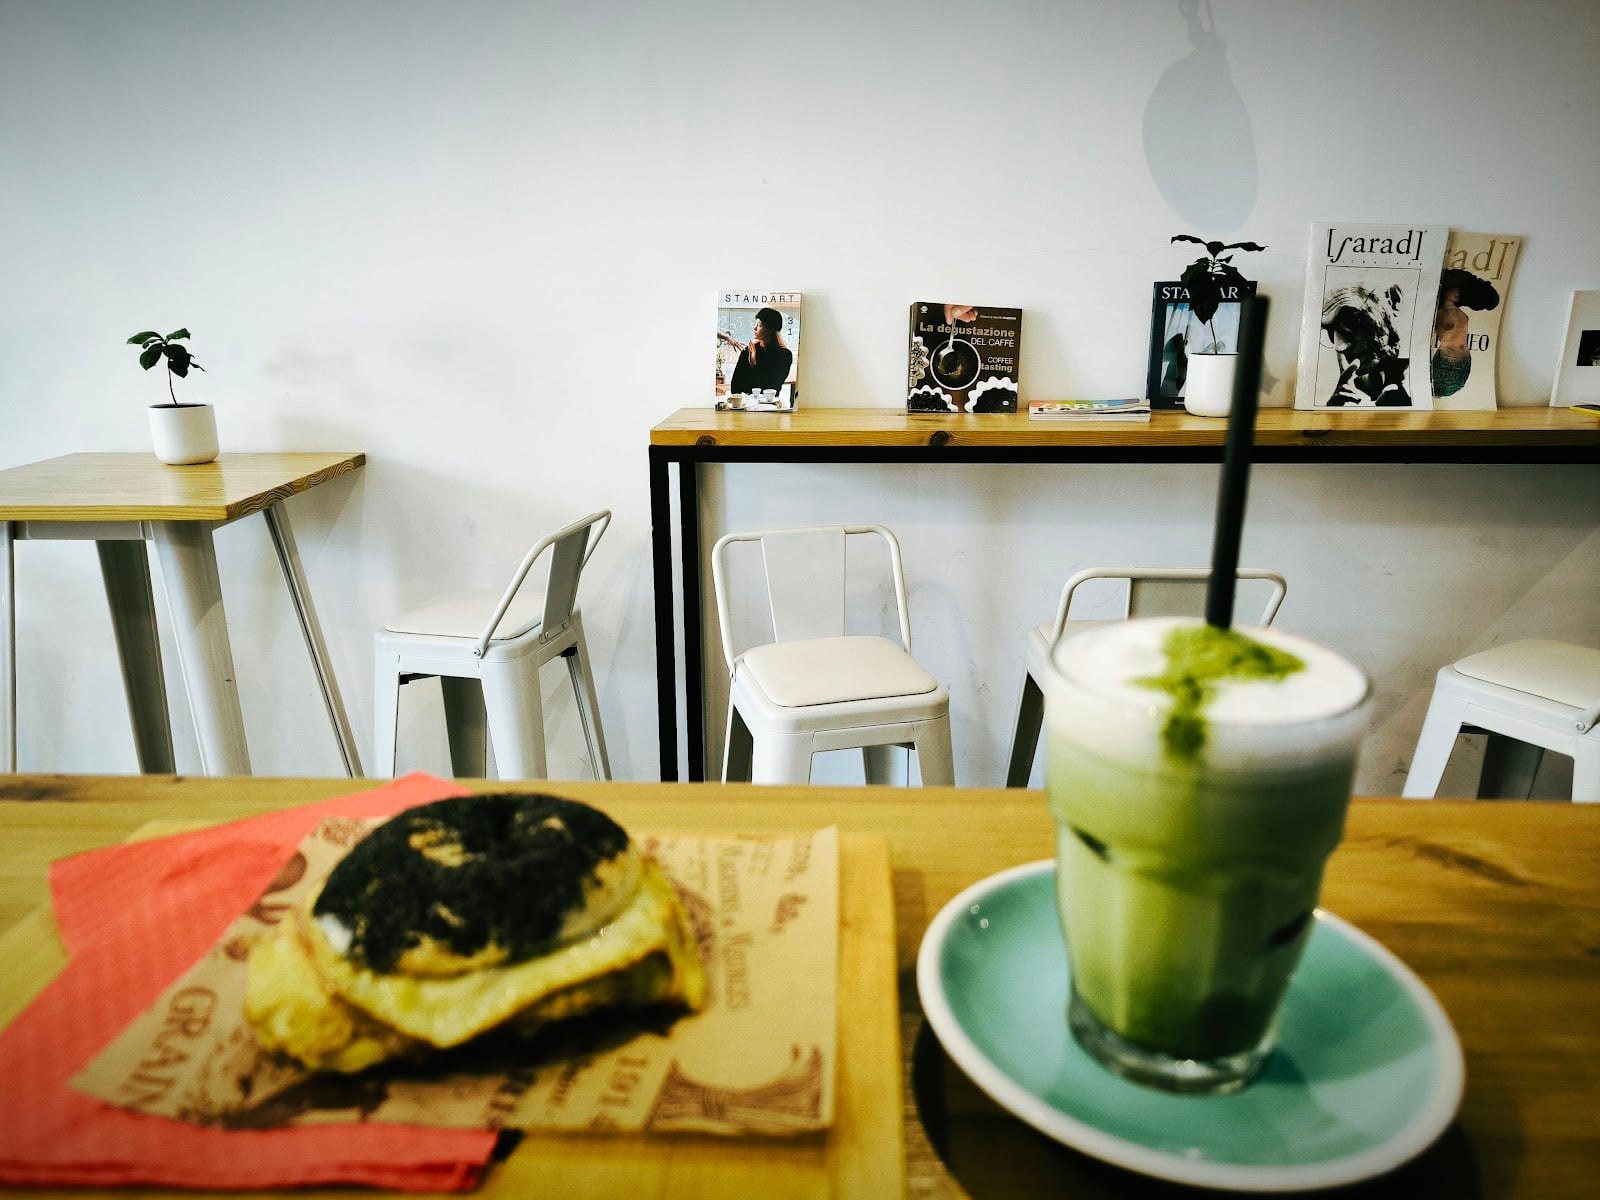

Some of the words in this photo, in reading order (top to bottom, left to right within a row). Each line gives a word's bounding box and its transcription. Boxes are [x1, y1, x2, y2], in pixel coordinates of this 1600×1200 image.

[725, 294, 794, 303] STANDART
[920, 322, 934, 332] La
[937, 323, 1015, 337] degustazione
[971, 337, 987, 346] DEL
[989, 338, 1015, 348] CAFFÈ
[987, 356, 1014, 365] COFFEE
[981, 363, 1013, 373] tasting
